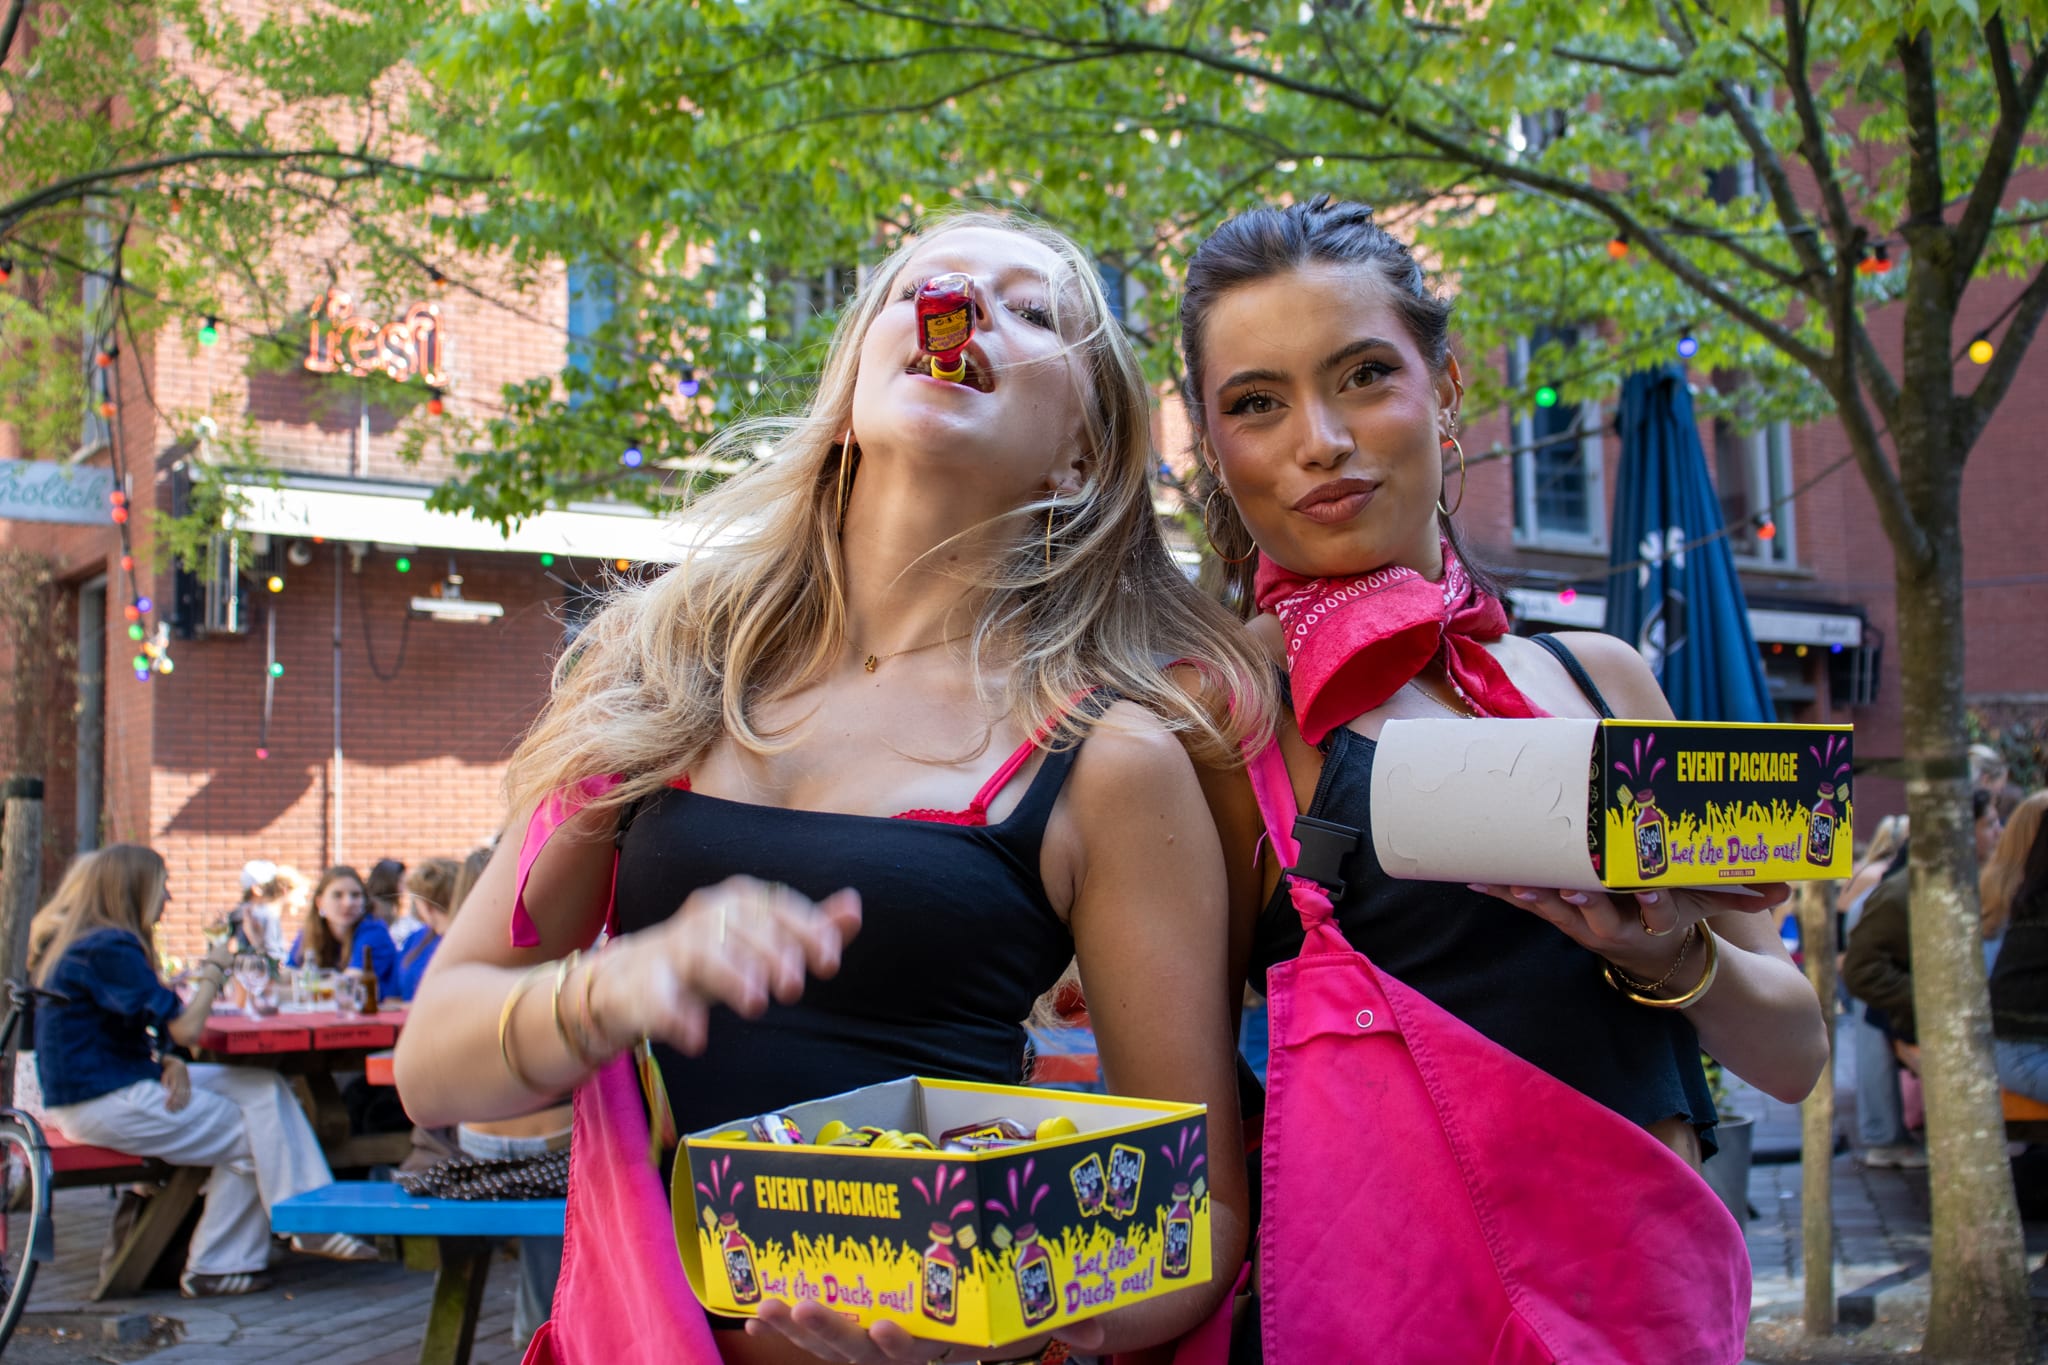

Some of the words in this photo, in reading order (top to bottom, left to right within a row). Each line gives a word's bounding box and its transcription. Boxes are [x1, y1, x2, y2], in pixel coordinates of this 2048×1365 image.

[1677, 751, 1726, 782] EVENT
[1729, 752, 1799, 782] PACKAGE
[1671, 841, 1694, 865] Let
[1699, 835, 1723, 865] the
[1727, 834, 1769, 865] Duck
[1773, 833, 1803, 863] out!
[754, 1174, 809, 1212] EVENT
[812, 1178, 902, 1220] PACKAGE
[1073, 1250, 1103, 1277] Let
[1107, 1236, 1137, 1272] the
[761, 1270, 788, 1294] Let
[793, 1270, 820, 1300] the
[823, 1274, 873, 1307] Duck
[879, 1281, 915, 1313] out!
[1064, 1270, 1116, 1315] Duck
[1120, 1257, 1156, 1293] out!
